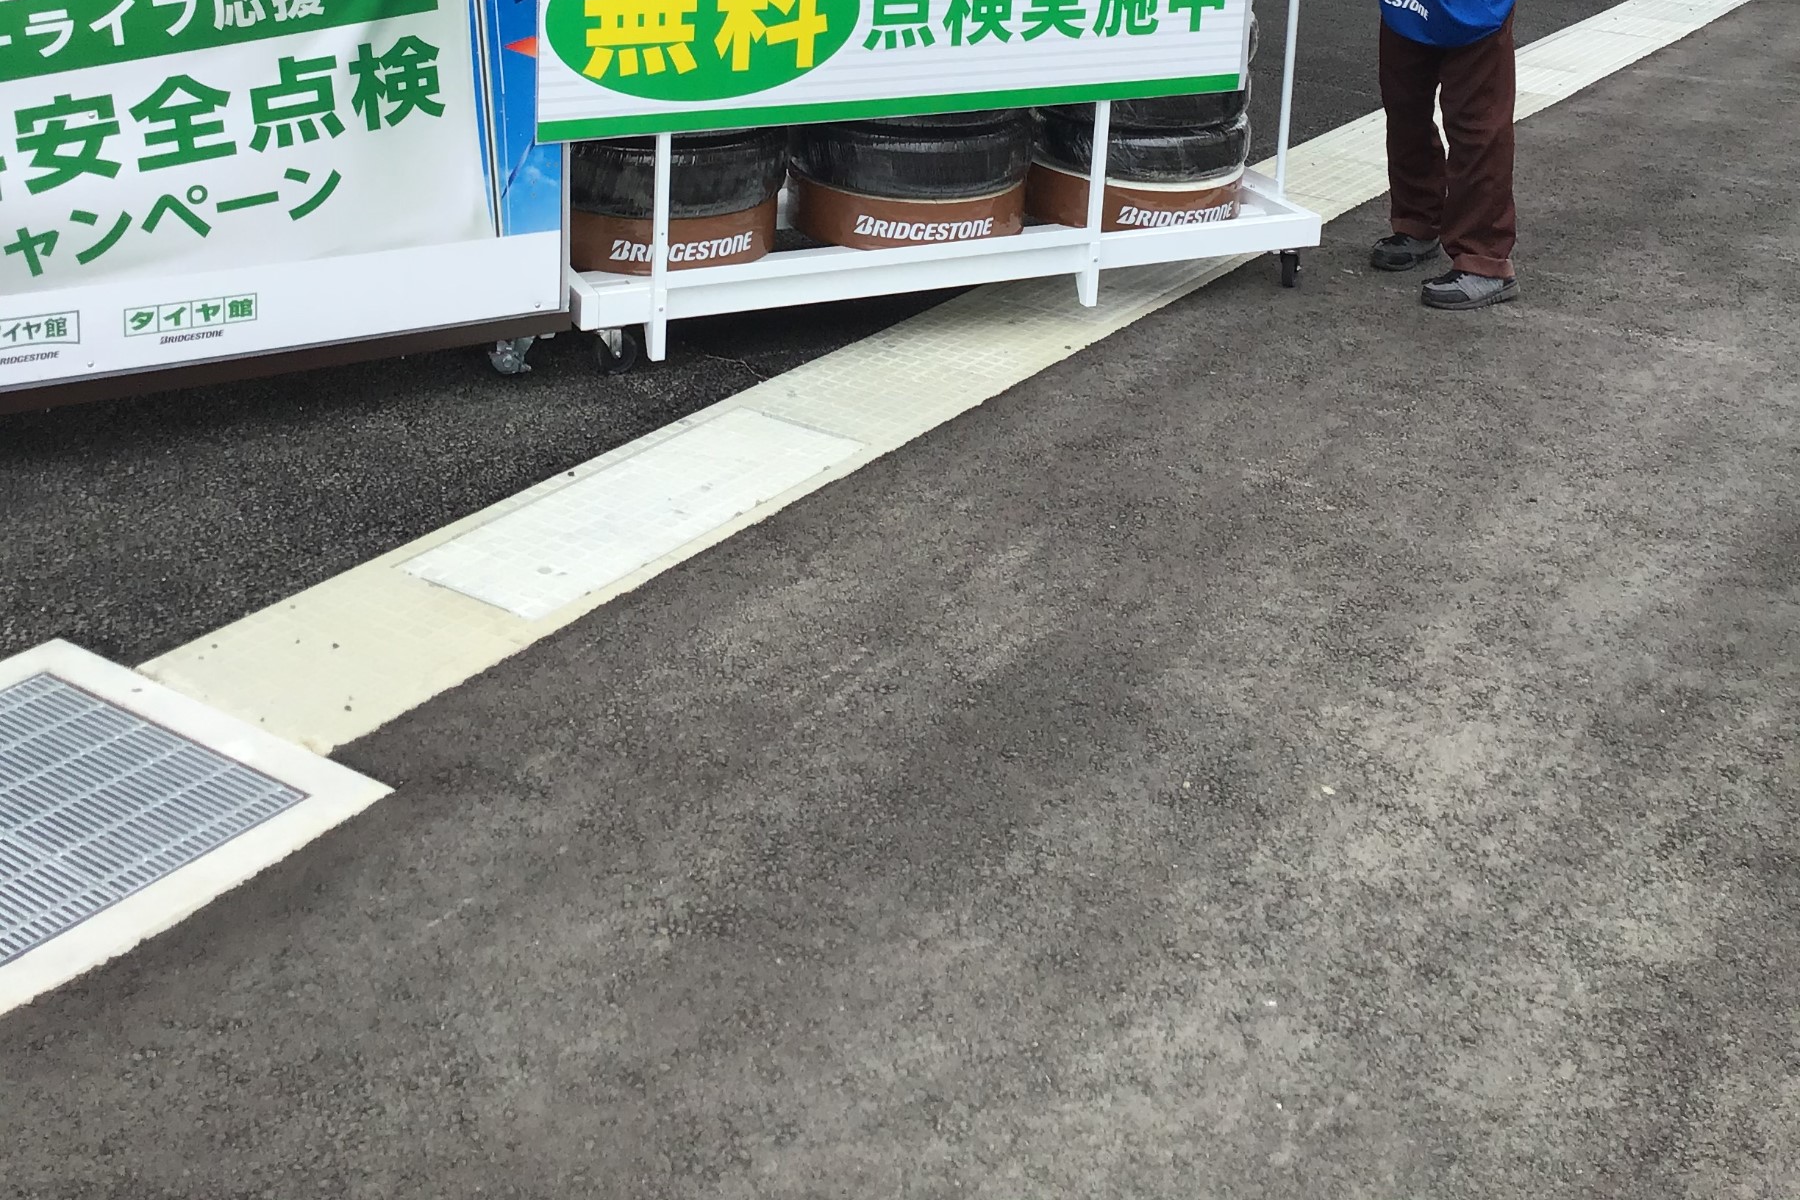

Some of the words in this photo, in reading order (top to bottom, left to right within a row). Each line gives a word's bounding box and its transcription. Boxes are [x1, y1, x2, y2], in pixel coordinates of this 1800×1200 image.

[0, 35, 446, 198] 安全点検
[853, 214, 994, 241] BRIDGESTONE
[1117, 201, 1234, 227] BRIDGESTONE
[609, 230, 753, 262] BRIGESTONE
[0, 317, 68, 342] イヤ館
[129, 298, 254, 331] タイヤ館
[160, 329, 224, 345] BRIDGESTONE
